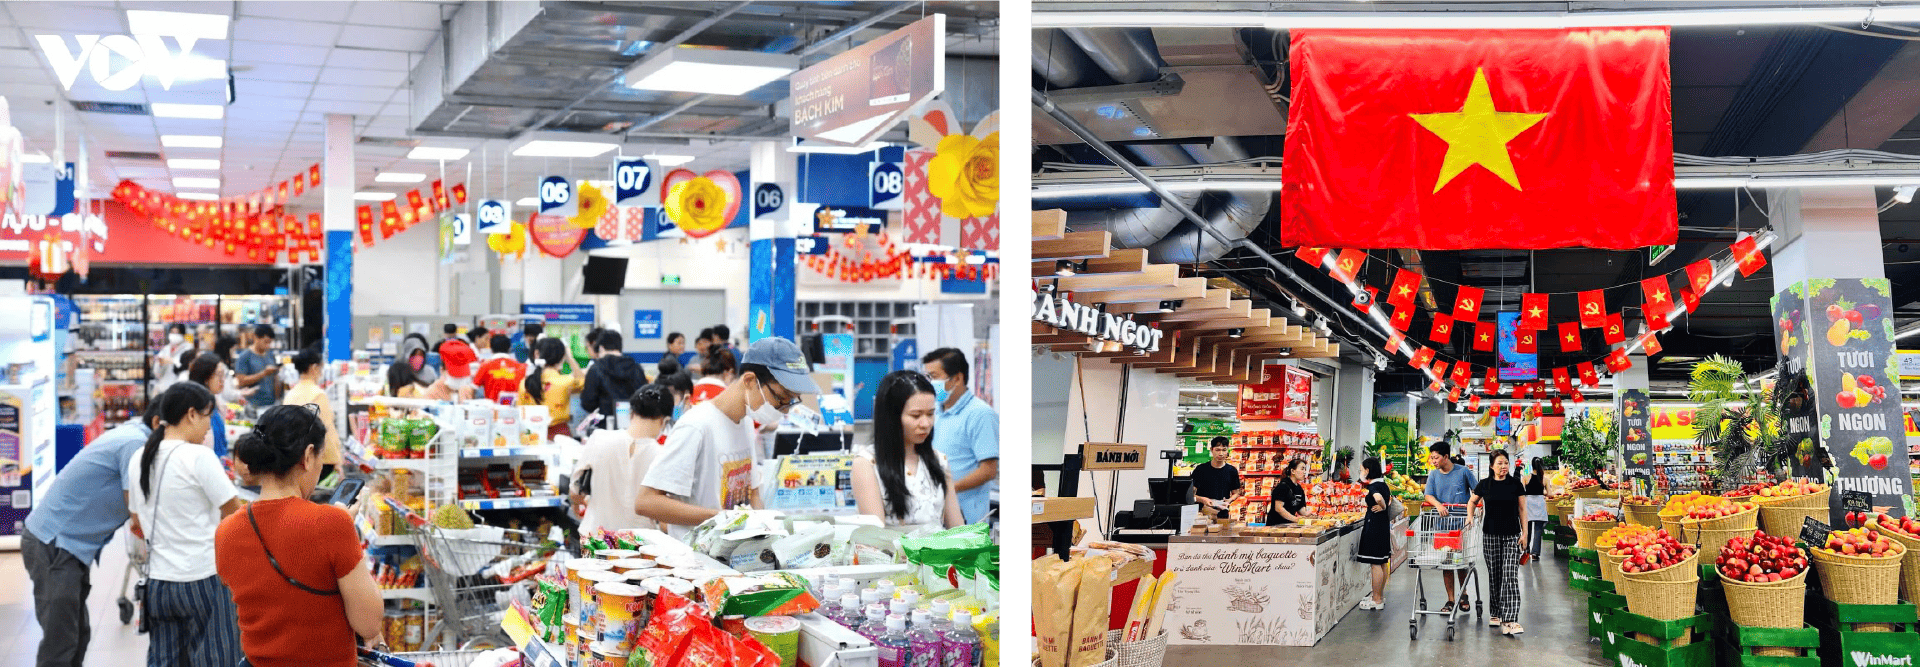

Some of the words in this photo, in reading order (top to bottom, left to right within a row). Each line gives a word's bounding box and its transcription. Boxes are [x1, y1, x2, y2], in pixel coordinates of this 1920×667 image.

[794, 101, 822, 126] BẠCH
[824, 94, 844, 116] KIM
[617, 165, 649, 190] 07
[874, 171, 902, 193] 08
[757, 189, 781, 208] 06
[1103, 312, 1163, 355] NGỌT
[1837, 350, 1875, 368] TƯƠI
[1790, 416, 1811, 434] NGON
[1838, 413, 1887, 431] NGON
[1095, 449, 1122, 463] BÁNH
[1123, 449, 1140, 463] MỚI
[1626, 443, 1646, 451] NGON
[1836, 475, 1904, 498] THƯỢNG
[1255, 547, 1298, 564] baguette
[1219, 560, 1272, 574] WinMart
[1850, 650, 1913, 667] WinMart
